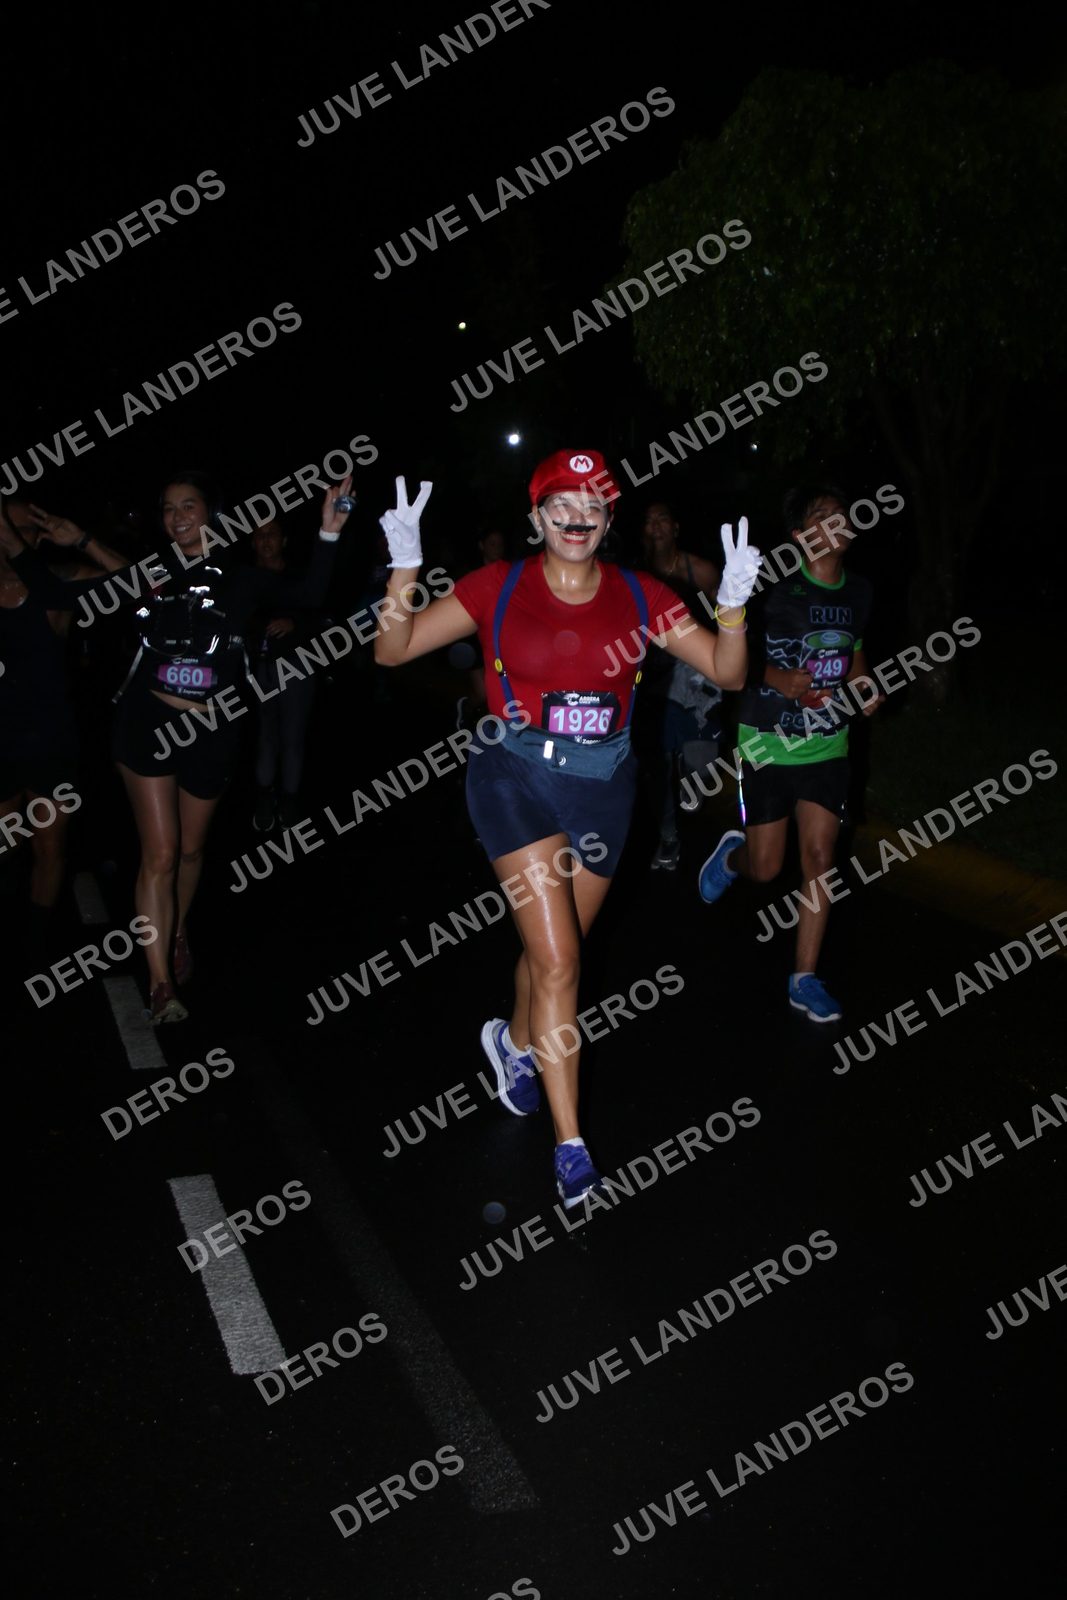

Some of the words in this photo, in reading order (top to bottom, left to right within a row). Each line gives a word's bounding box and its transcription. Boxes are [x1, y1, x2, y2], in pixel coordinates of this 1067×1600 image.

[574, 457, 589, 470] M
[810, 606, 852, 625] RUN
[166, 665, 204, 687] 660
[814, 658, 843, 679] 249
[554, 708, 611, 732] 1926
